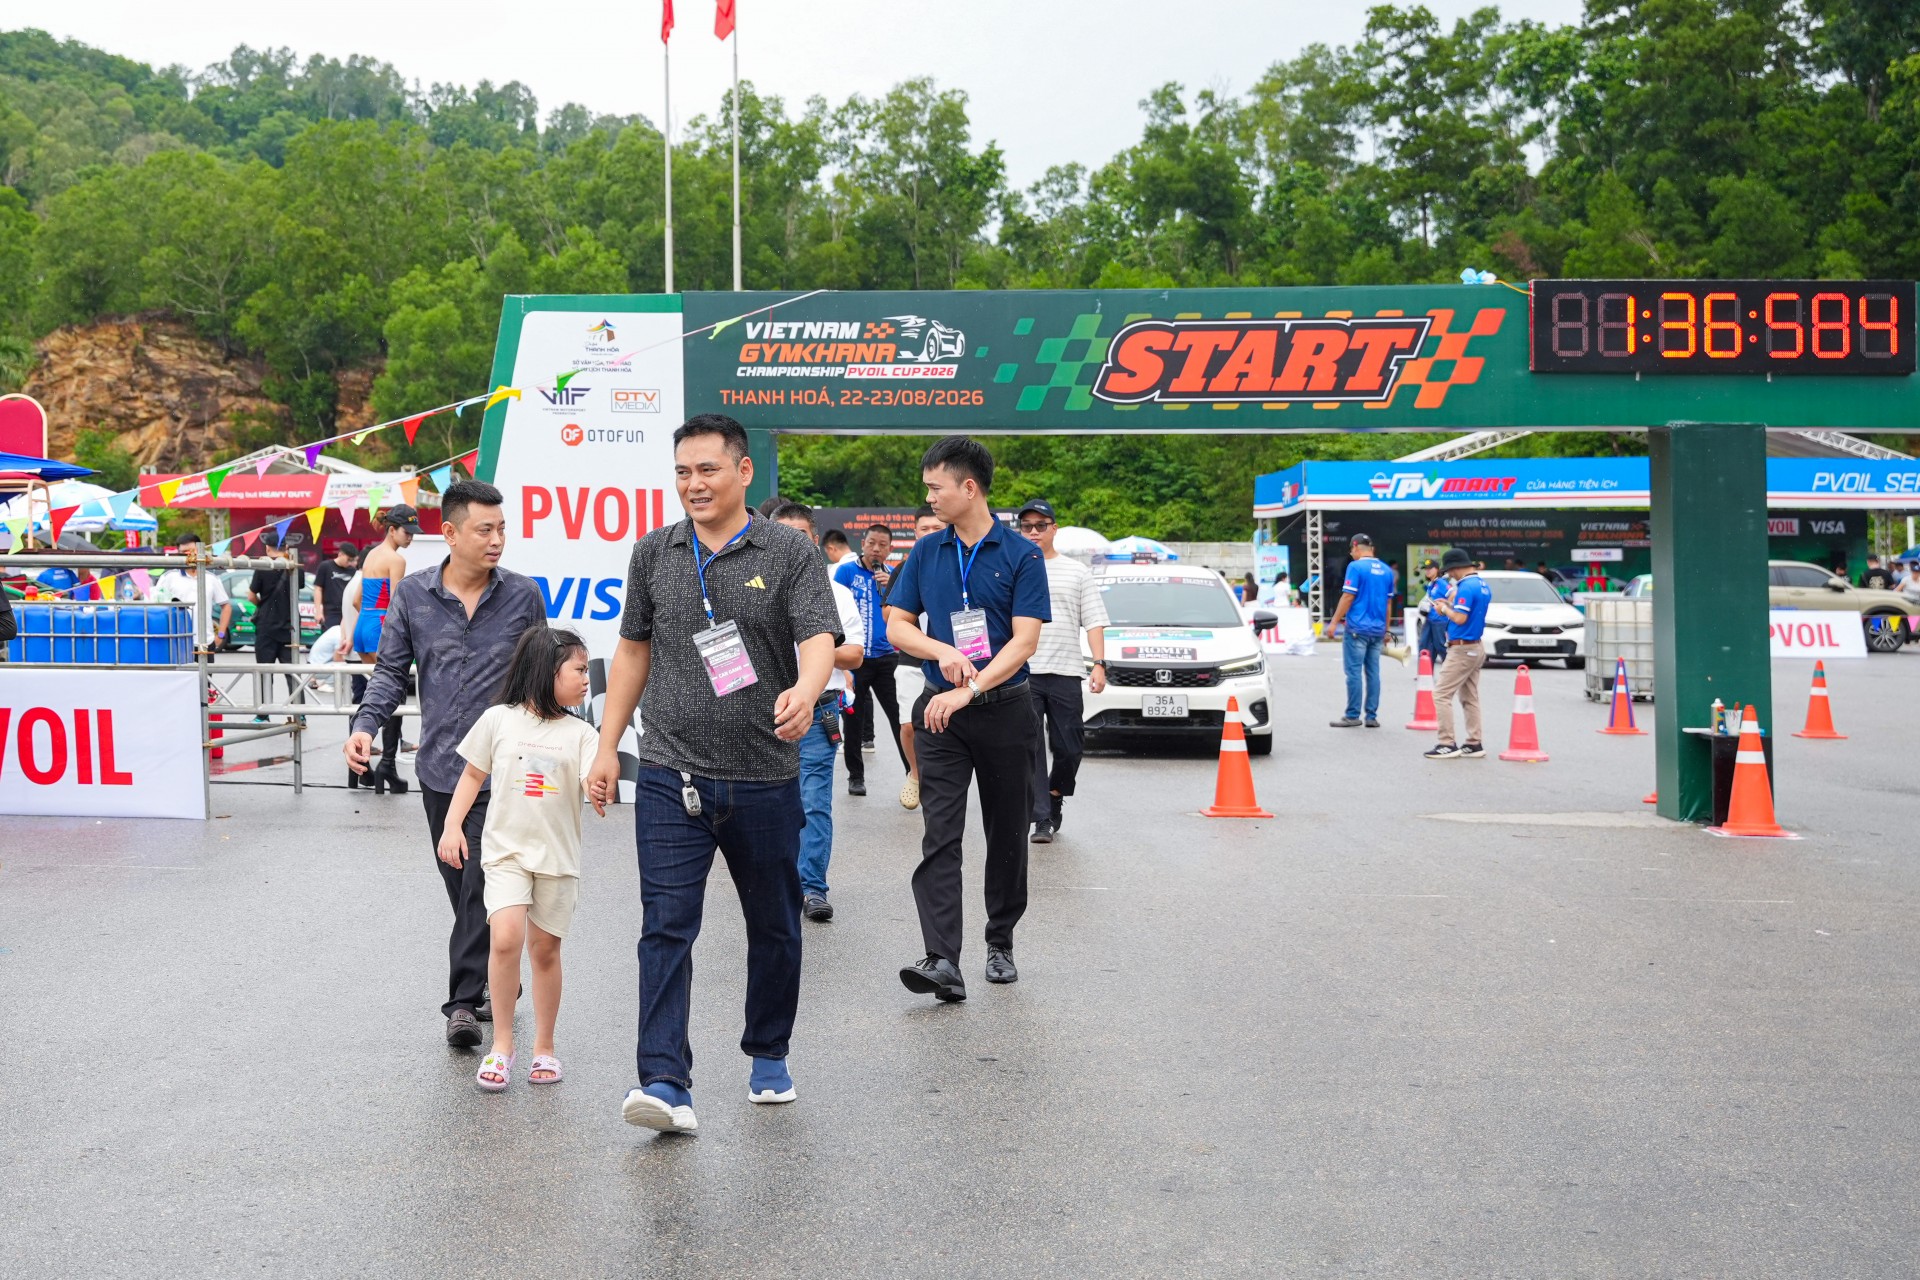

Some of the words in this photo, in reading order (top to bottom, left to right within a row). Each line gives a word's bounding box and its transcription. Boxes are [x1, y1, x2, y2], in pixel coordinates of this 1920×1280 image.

[745, 321, 861, 340] VIETNAM
[739, 343, 897, 363] GYMKHANA
[1104, 327, 1417, 394] START
[736, 366, 845, 377] CHAMPIONSHIP
[847, 366, 888, 377] PVOIL
[892, 366, 921, 377] CUP
[922, 366, 954, 377] 2026
[615, 391, 656, 402] OTV
[720, 389, 785, 405] THANH
[791, 386, 835, 407] HOÁ,
[840, 389, 984, 406] 22-23/08/2026
[615, 402, 658, 412] MEDIA
[588, 429, 644, 443] OTOFUN
[1548, 478, 1575, 490] HÀNG
[1811, 472, 1876, 492] PVOIL
[1500, 519, 1546, 527] GYMKHANA
[1580, 522, 1629, 531] VIETNAM
[1810, 520, 1846, 534] VISA
[528, 576, 623, 621] VIS
[1139, 646, 1192, 655] ROMIT
[718, 671, 729, 679] CAR
[728, 665, 743, 674] GAME
[1155, 696, 1175, 706] 36A
[1148, 706, 1183, 716] 892.48
